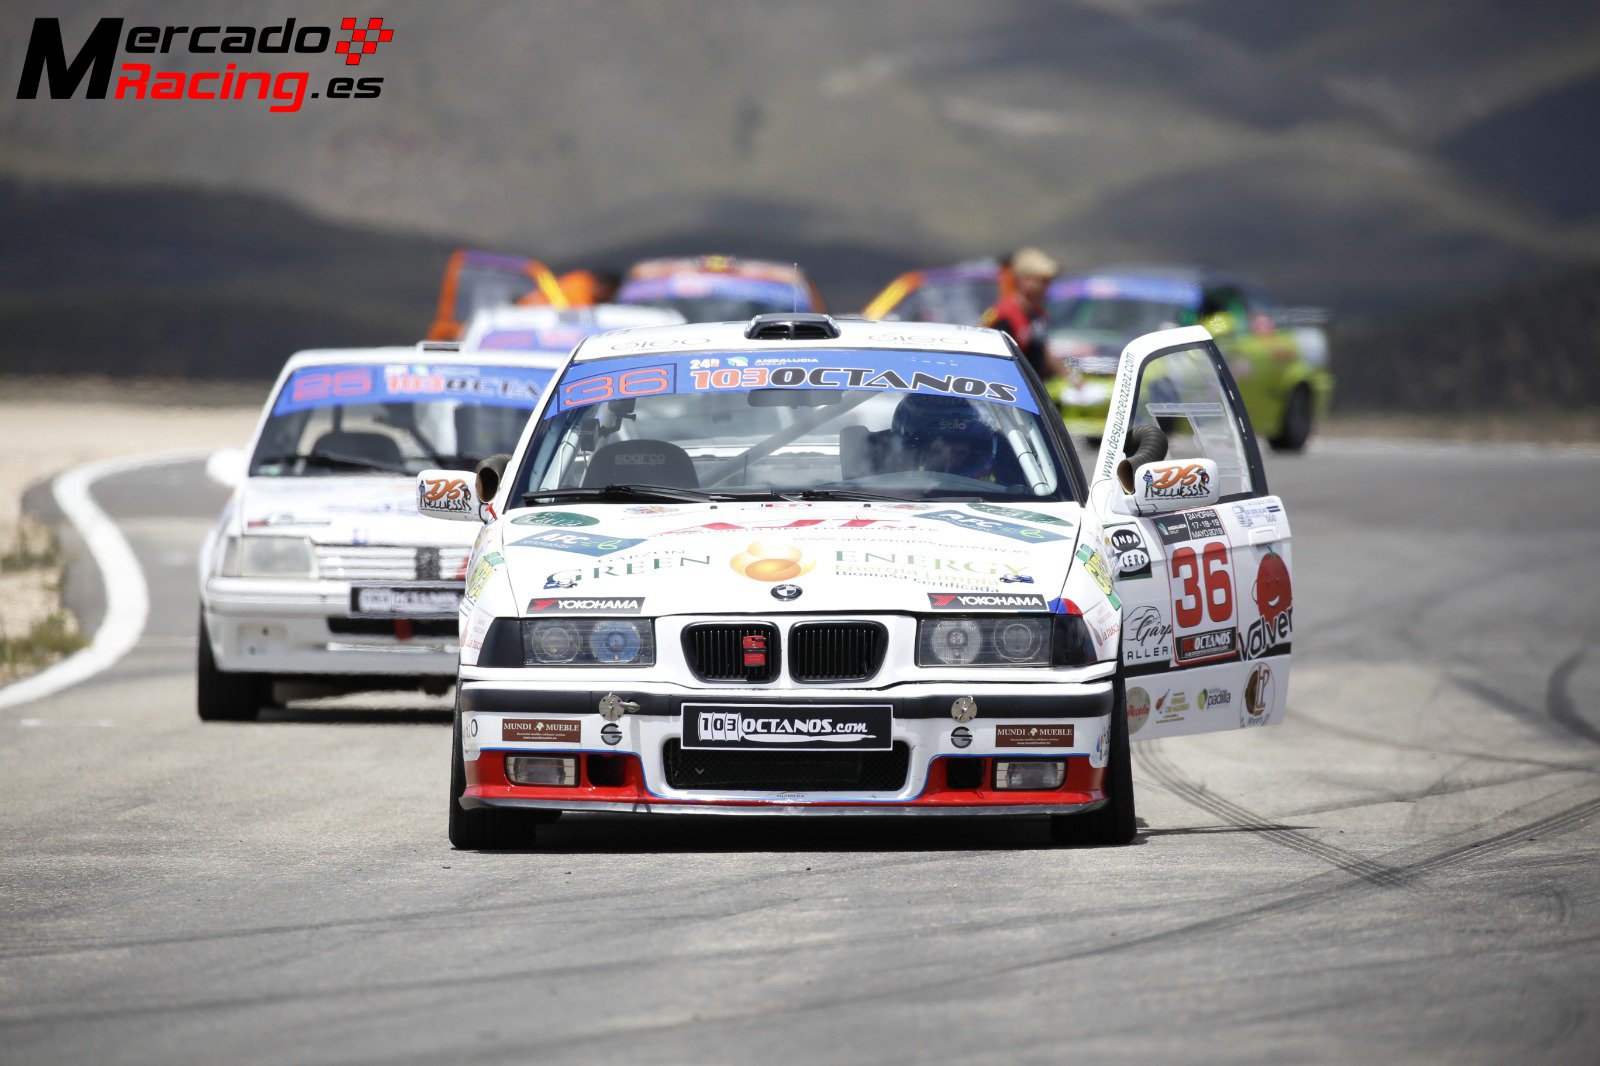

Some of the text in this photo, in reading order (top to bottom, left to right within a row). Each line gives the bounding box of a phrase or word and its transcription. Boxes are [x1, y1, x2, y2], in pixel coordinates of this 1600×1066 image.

[564, 368, 669, 406] 36
[690, 366, 1018, 403] 103OCTANOS
[614, 453, 666, 466] sparco
[1112, 533, 1140, 546] ONDA
[834, 550, 1030, 576] ENERGY
[547, 555, 711, 586] GREEN
[1171, 541, 1233, 629] 36
[557, 599, 639, 610] YOKOHAMA
[957, 595, 1043, 607] YOKOHAMA
[1122, 645, 1173, 661] ALLER
[503, 722, 580, 732] MUNDI MUEBLE
[997, 728, 1073, 736] MUNDI MUEBLE
